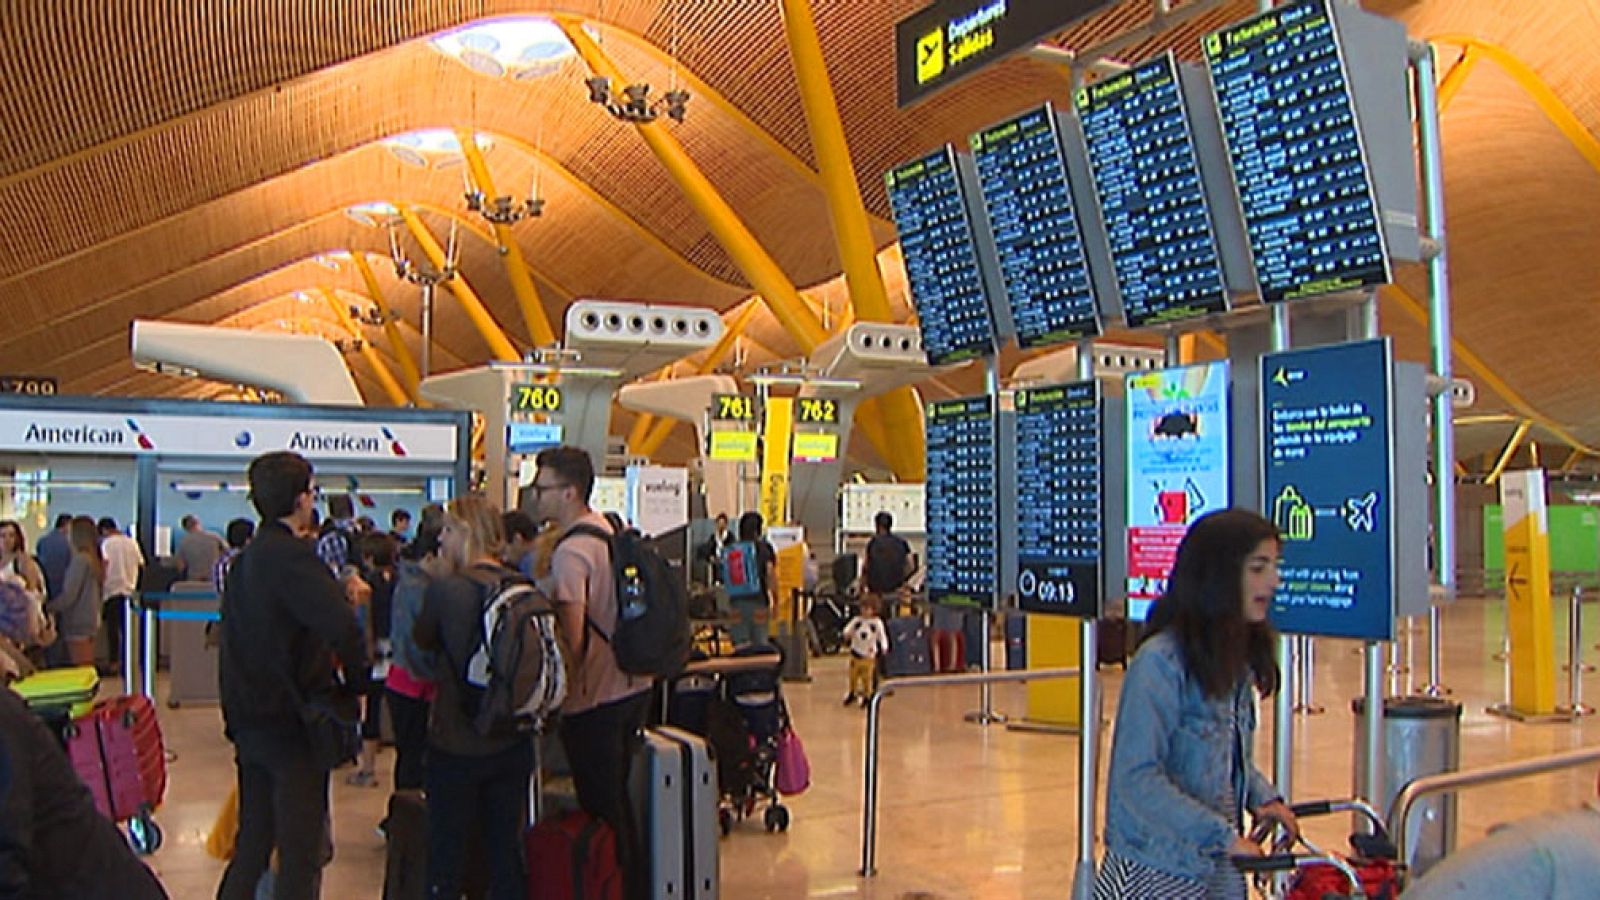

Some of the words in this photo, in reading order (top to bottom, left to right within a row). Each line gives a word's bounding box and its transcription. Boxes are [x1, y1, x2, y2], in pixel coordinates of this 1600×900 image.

[518, 387, 560, 410] 760
[719, 396, 753, 419] 761
[801, 399, 835, 422] 762
[25, 422, 124, 445] American
[289, 431, 380, 453] American
[645, 479, 680, 498] vueling
